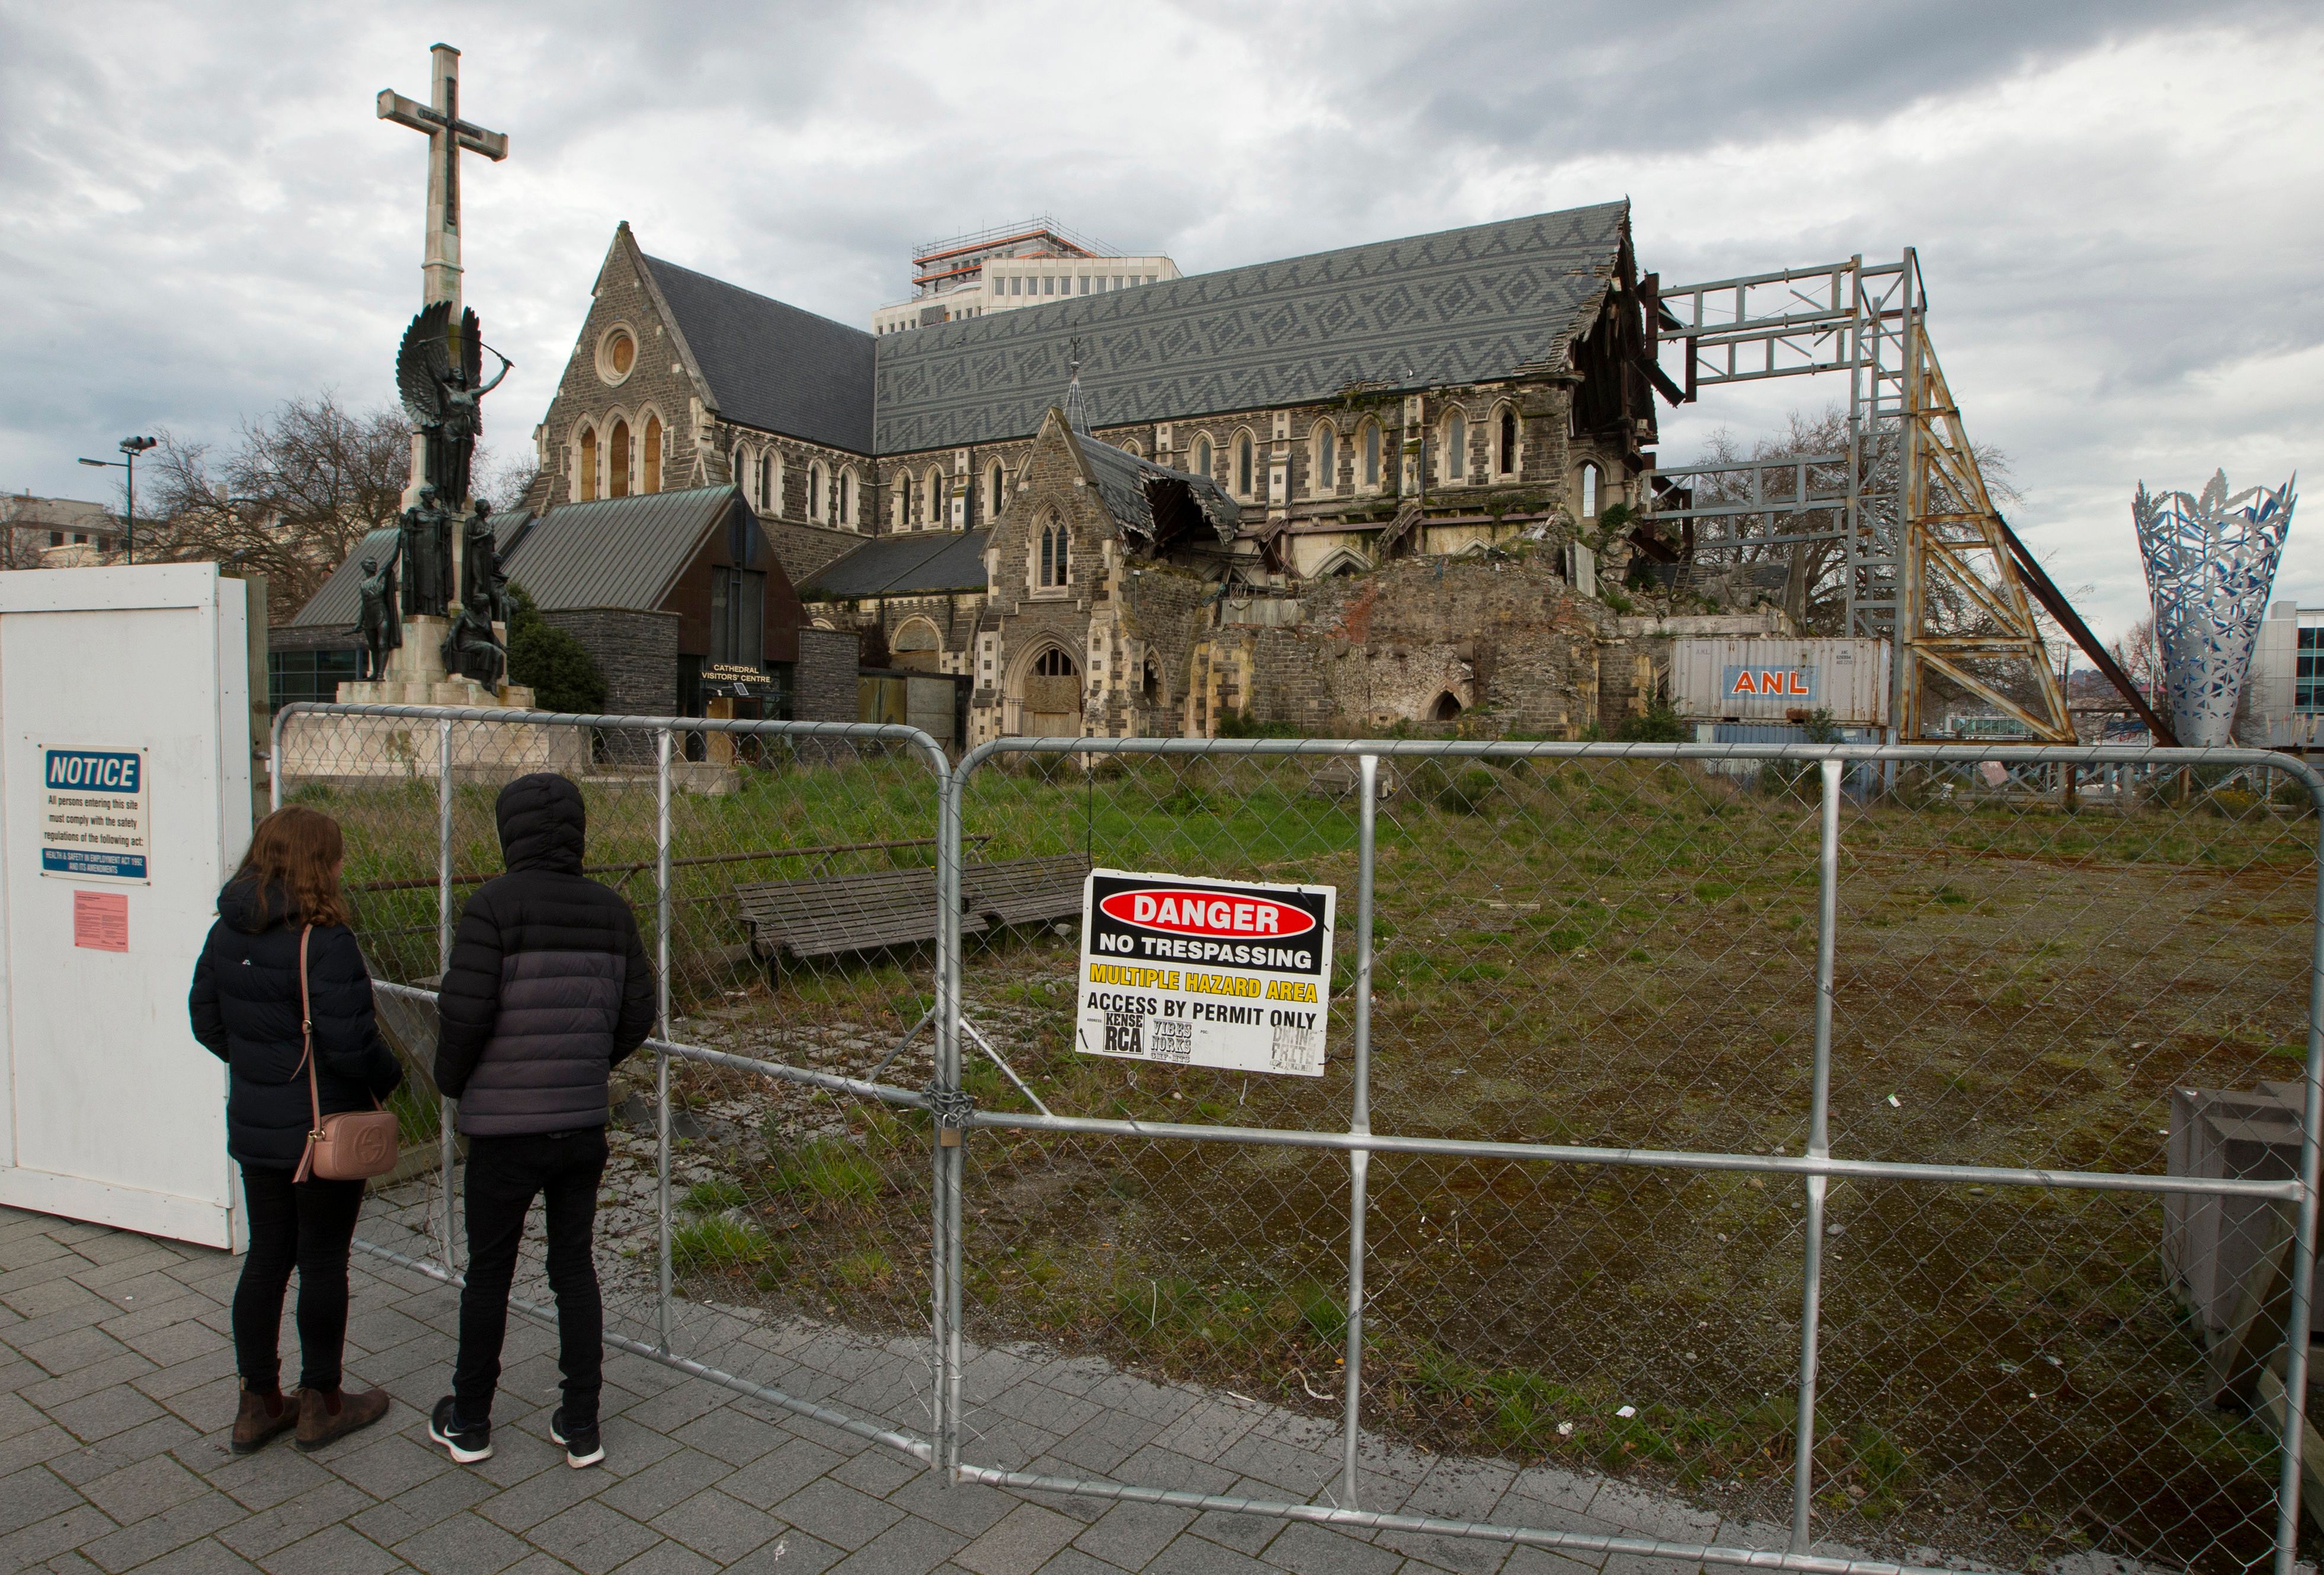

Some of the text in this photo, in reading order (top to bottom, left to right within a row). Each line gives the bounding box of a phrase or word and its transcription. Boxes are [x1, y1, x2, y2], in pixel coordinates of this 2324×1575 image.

[702, 672, 739, 681] VISITORS'
[713, 664, 759, 674] CATHEDRAL
[1731, 670, 1808, 695] ANL
[50, 756, 136, 787] NOTICE
[49, 795, 138, 810] All persons entering this site
[49, 814, 137, 830] must comply with the safety
[44, 831, 143, 847] regulations of the following act:
[46, 851, 62, 860] HEALTH
[67, 853, 84, 861] SAFETY
[90, 854, 121, 864] EMPLOYMENT
[132, 857, 143, 866] 1992
[69, 862, 78, 870] AND
[87, 863, 118, 873] AMENDMENTS
[1134, 895, 1279, 933] DANGER
[1099, 933, 1312, 969] NO TRESPASSING
[1090, 963, 1318, 1003] MULTIPLE HAZARD AREA
[1087, 992, 1317, 1030] ACCESS BY PERMIT ONLY
[1106, 1013, 1143, 1027] KENSE
[1153, 1020, 1192, 1038] VIBES
[1105, 1026, 1142, 1052] RCA
